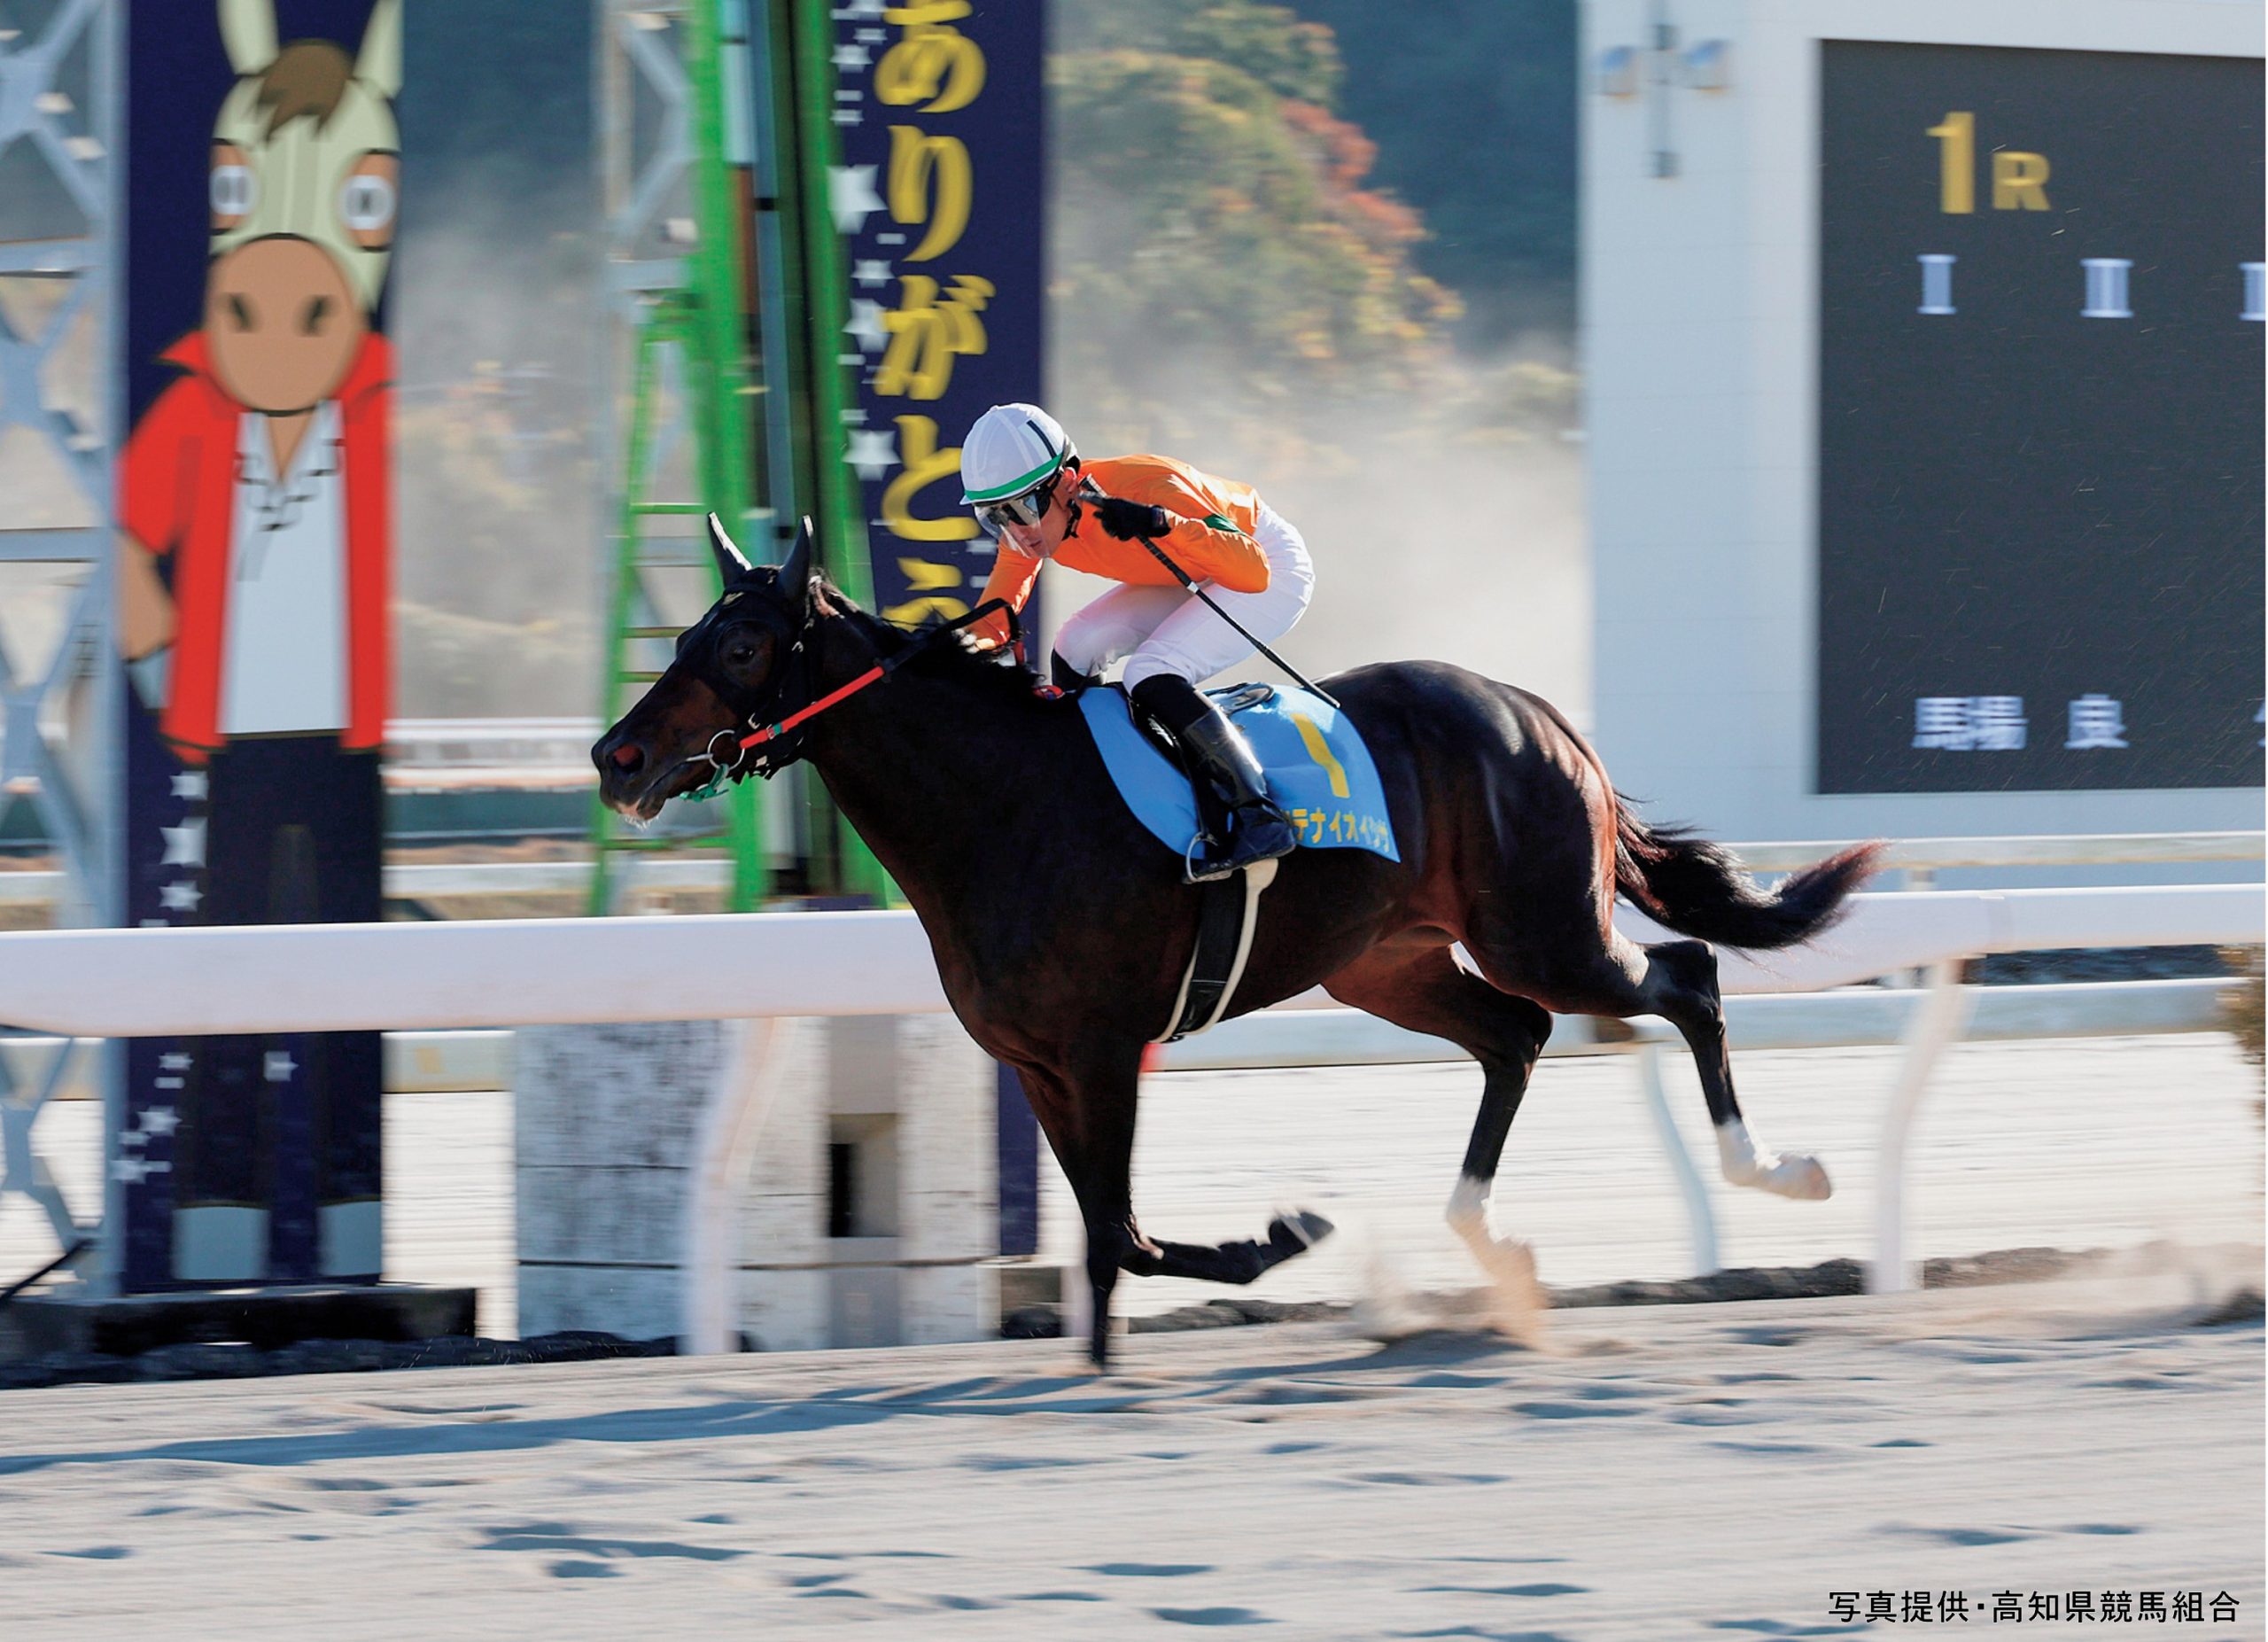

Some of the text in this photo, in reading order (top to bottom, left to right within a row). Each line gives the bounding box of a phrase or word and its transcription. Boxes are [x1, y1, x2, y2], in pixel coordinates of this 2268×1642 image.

[1291, 712, 1350, 798] 1
[1912, 693, 2129, 751] 馬場 良
